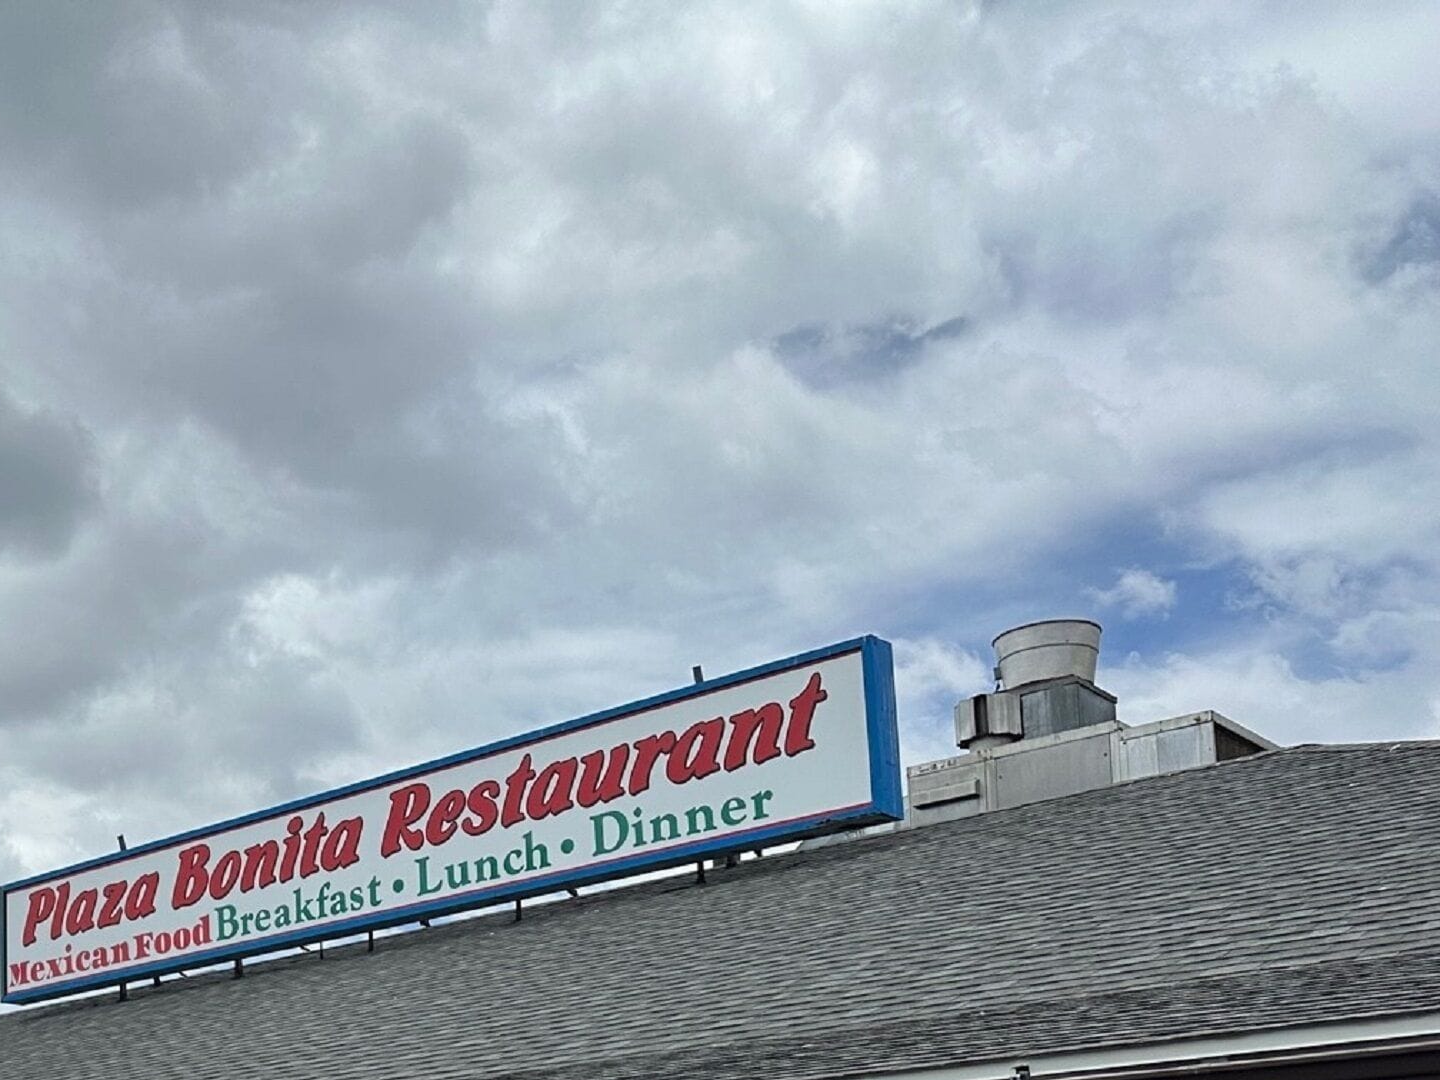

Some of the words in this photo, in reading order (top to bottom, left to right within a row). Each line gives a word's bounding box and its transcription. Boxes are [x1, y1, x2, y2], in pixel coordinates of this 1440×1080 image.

[9, 943, 131, 985] Mexican
[132, 915, 213, 957] Food
[215, 874, 383, 941] Breakfast
[415, 830, 552, 897] Lunch
[589, 789, 774, 857] Dinner
[22, 880, 160, 947] Plaza
[171, 811, 364, 910] Bonita
[380, 671, 828, 859] Restaurant
